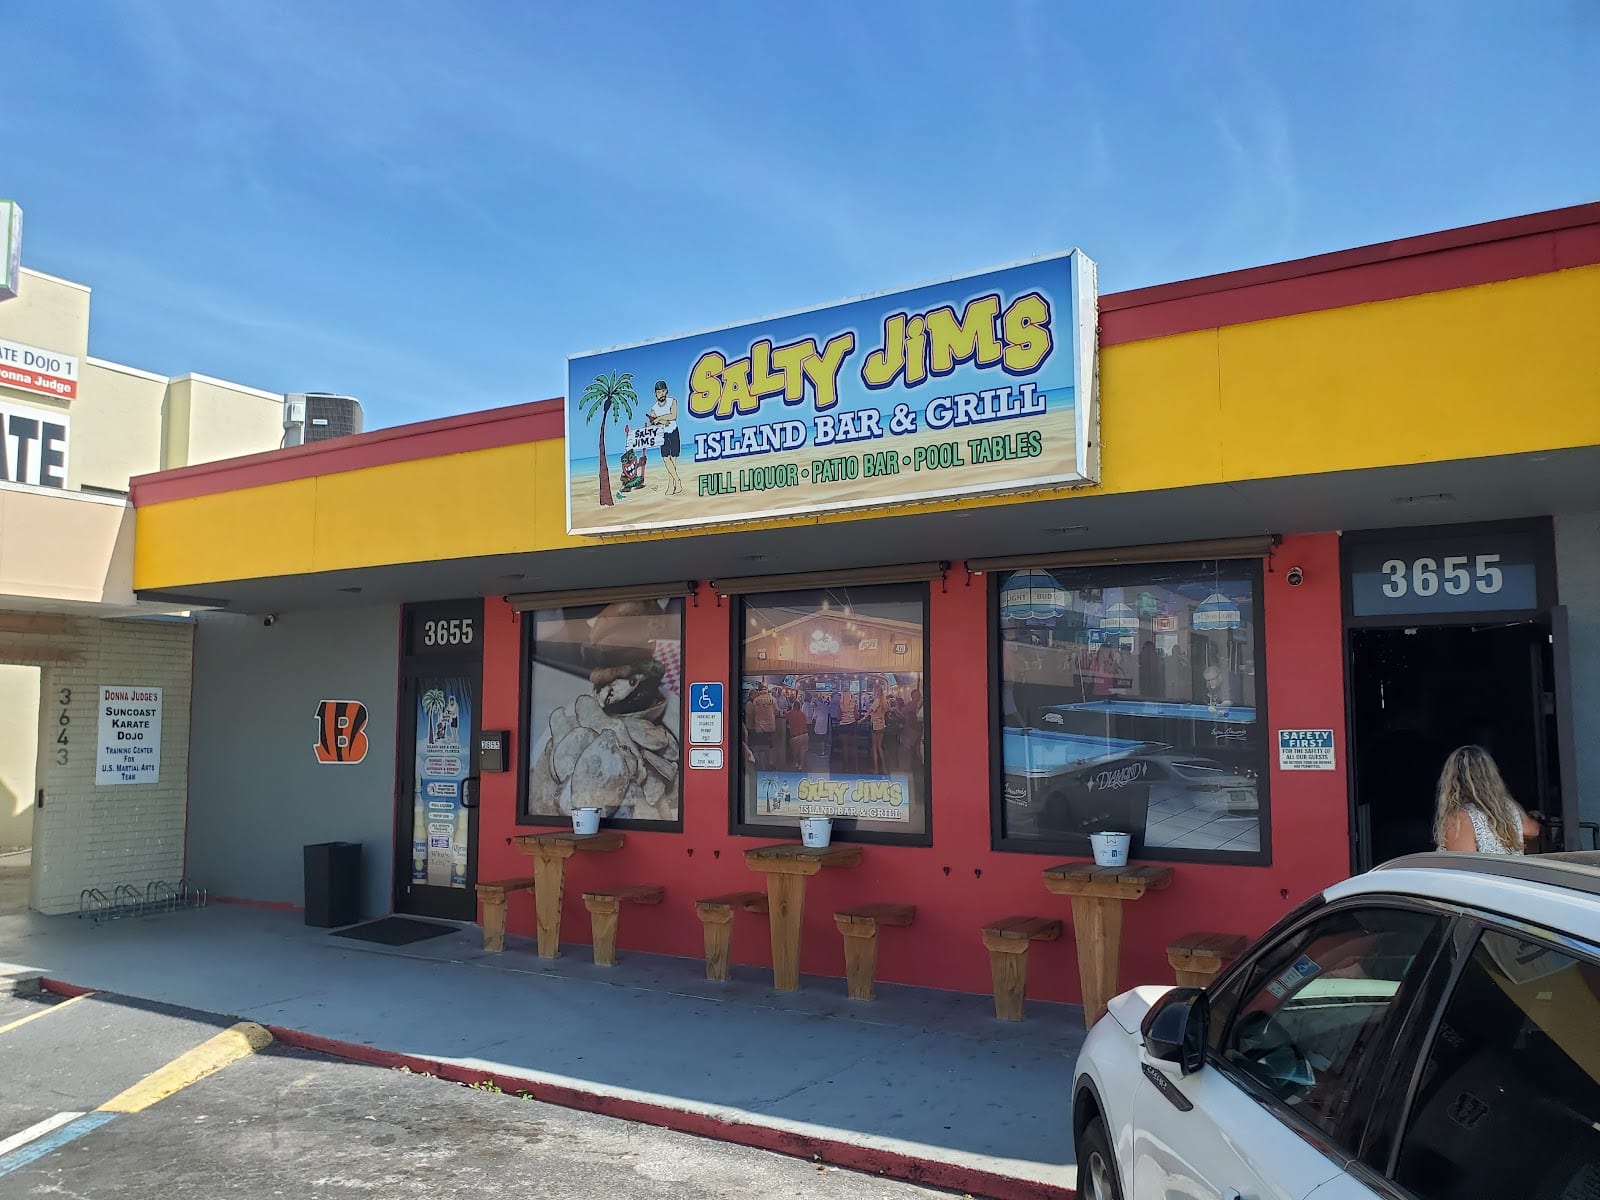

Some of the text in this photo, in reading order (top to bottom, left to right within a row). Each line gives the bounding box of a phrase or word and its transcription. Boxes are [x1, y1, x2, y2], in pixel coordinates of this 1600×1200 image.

[24, 351, 60, 372] DOJO
[65, 361, 72, 375] 1
[0, 368, 72, 393] onna Judge
[688, 331, 855, 421] SALTY
[694, 382, 1047, 463] ISLAND BAR & GRILL
[635, 428, 658, 439] SALTY
[698, 430, 1043, 496] FULL LIQUOR PATIO BAR POOL TABLES
[1381, 554, 1503, 598] 3655
[424, 618, 473, 646] 3655
[105, 690, 158, 701] DONNA JUDGE'S
[105, 706, 157, 717] SUNCOAST
[57, 688, 72, 766] 3643
[112, 719, 150, 728] KARATE
[117, 731, 144, 740] DOJO
[1282, 731, 1329, 740] SAFETY
[106, 746, 153, 754] TRAINING CENTER
[124, 755, 135, 763] FOR
[102, 763, 155, 772] U.S. MARTIAL ARTS
[798, 778, 850, 805] SALTY
[800, 805, 902, 819] ISLAND BAR & GRILL
